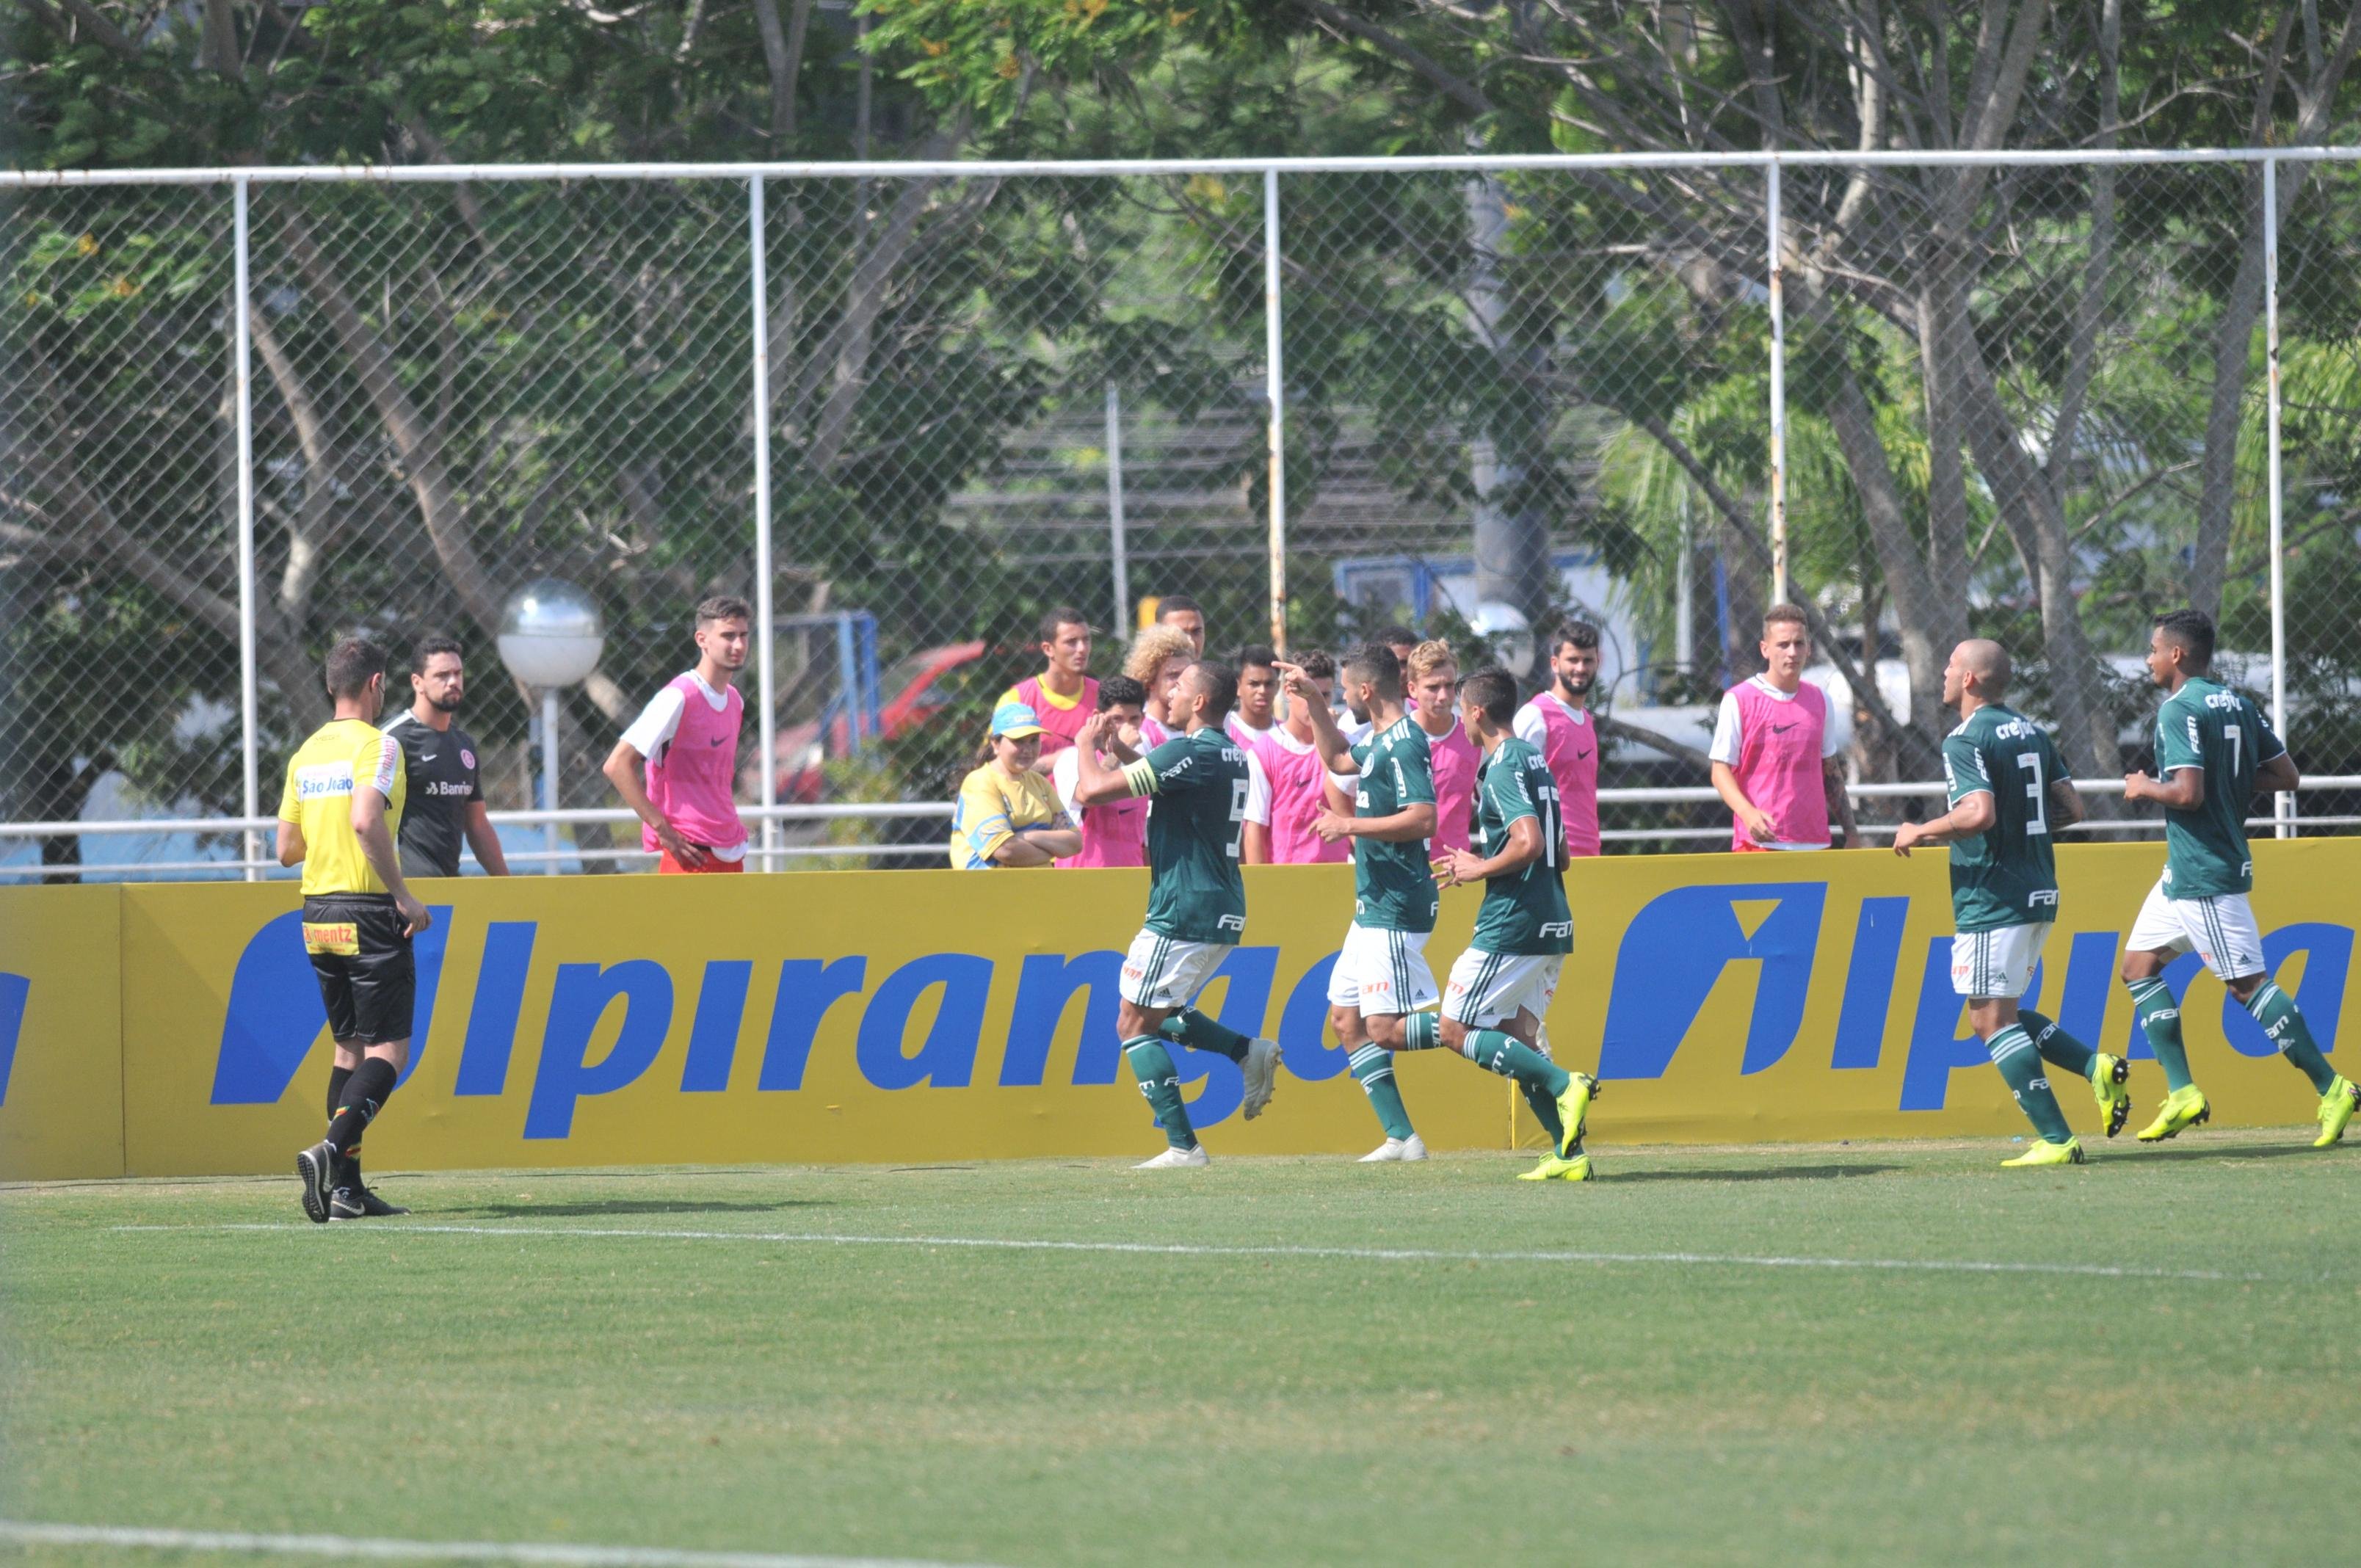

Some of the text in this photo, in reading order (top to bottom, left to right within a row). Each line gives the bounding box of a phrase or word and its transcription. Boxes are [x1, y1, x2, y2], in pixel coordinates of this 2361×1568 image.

[302, 774, 353, 794] São João
[2224, 725, 2242, 778] 7
[1225, 778, 1249, 857] 9
[2017, 752, 2048, 835] 3
